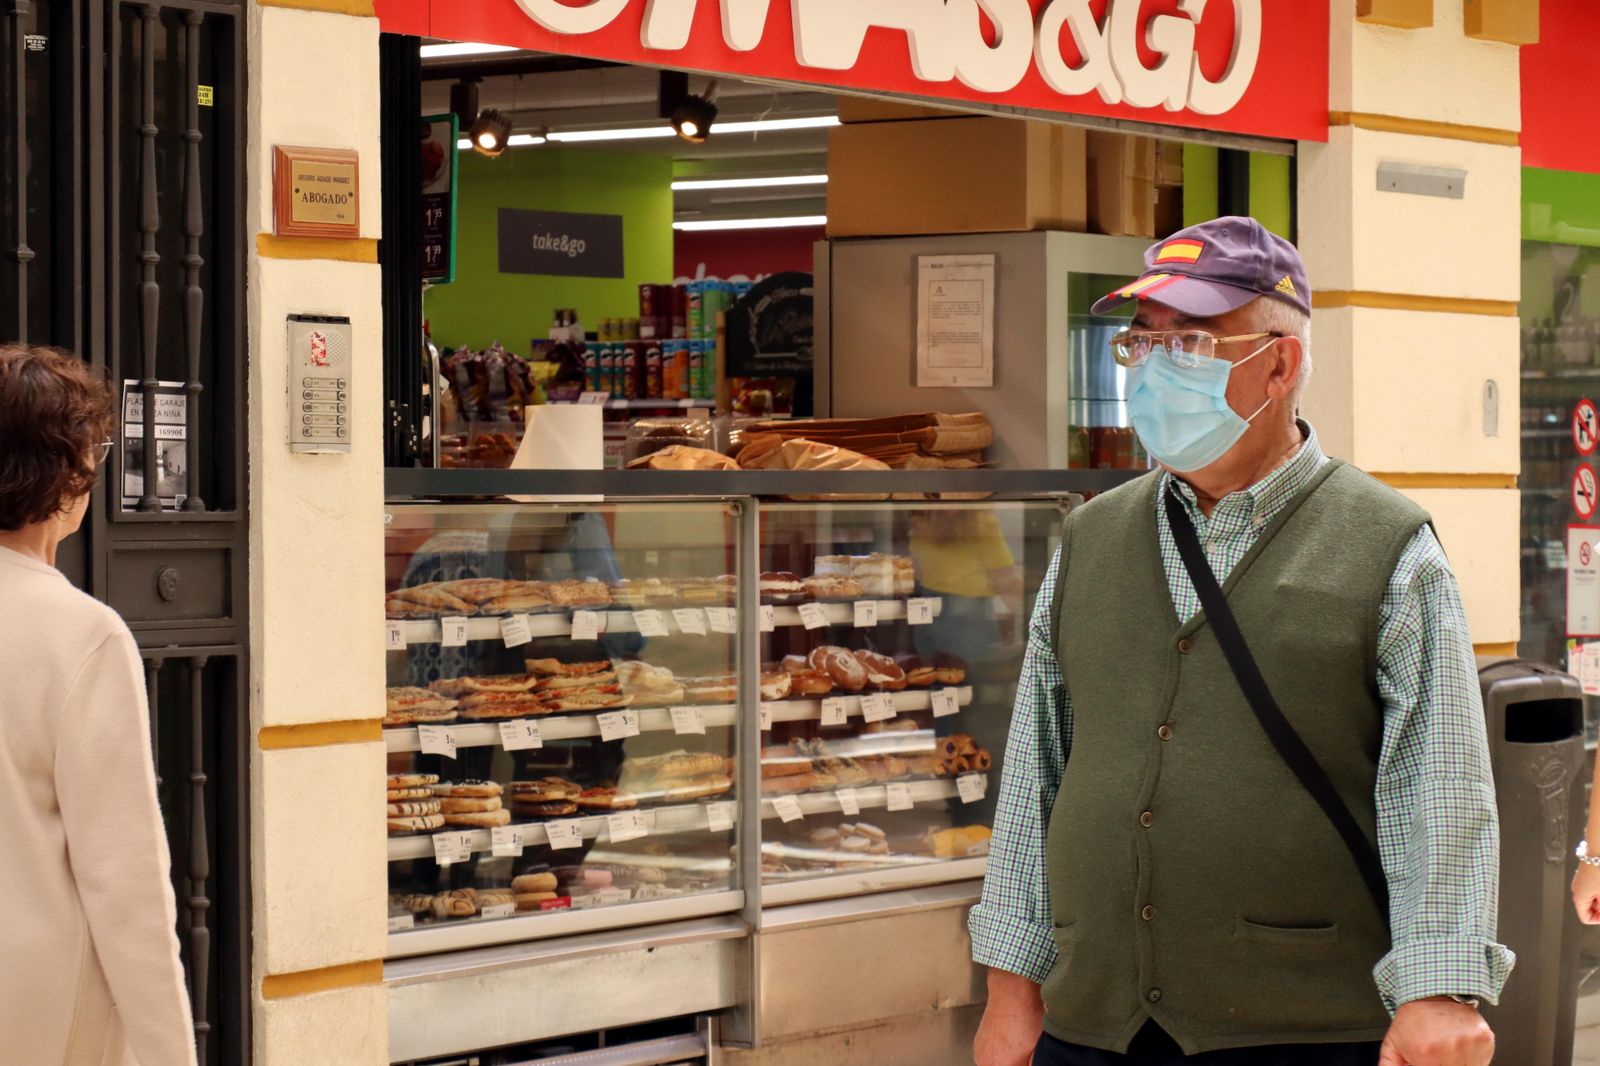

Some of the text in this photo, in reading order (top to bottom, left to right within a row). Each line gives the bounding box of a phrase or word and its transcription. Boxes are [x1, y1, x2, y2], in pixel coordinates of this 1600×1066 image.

[302, 192, 347, 204] ABOGADO
[532, 231, 586, 258] take&go
[127, 397, 143, 406] PLAZ
[159, 399, 185, 408] GARAJE
[164, 408, 181, 417] NIÑA
